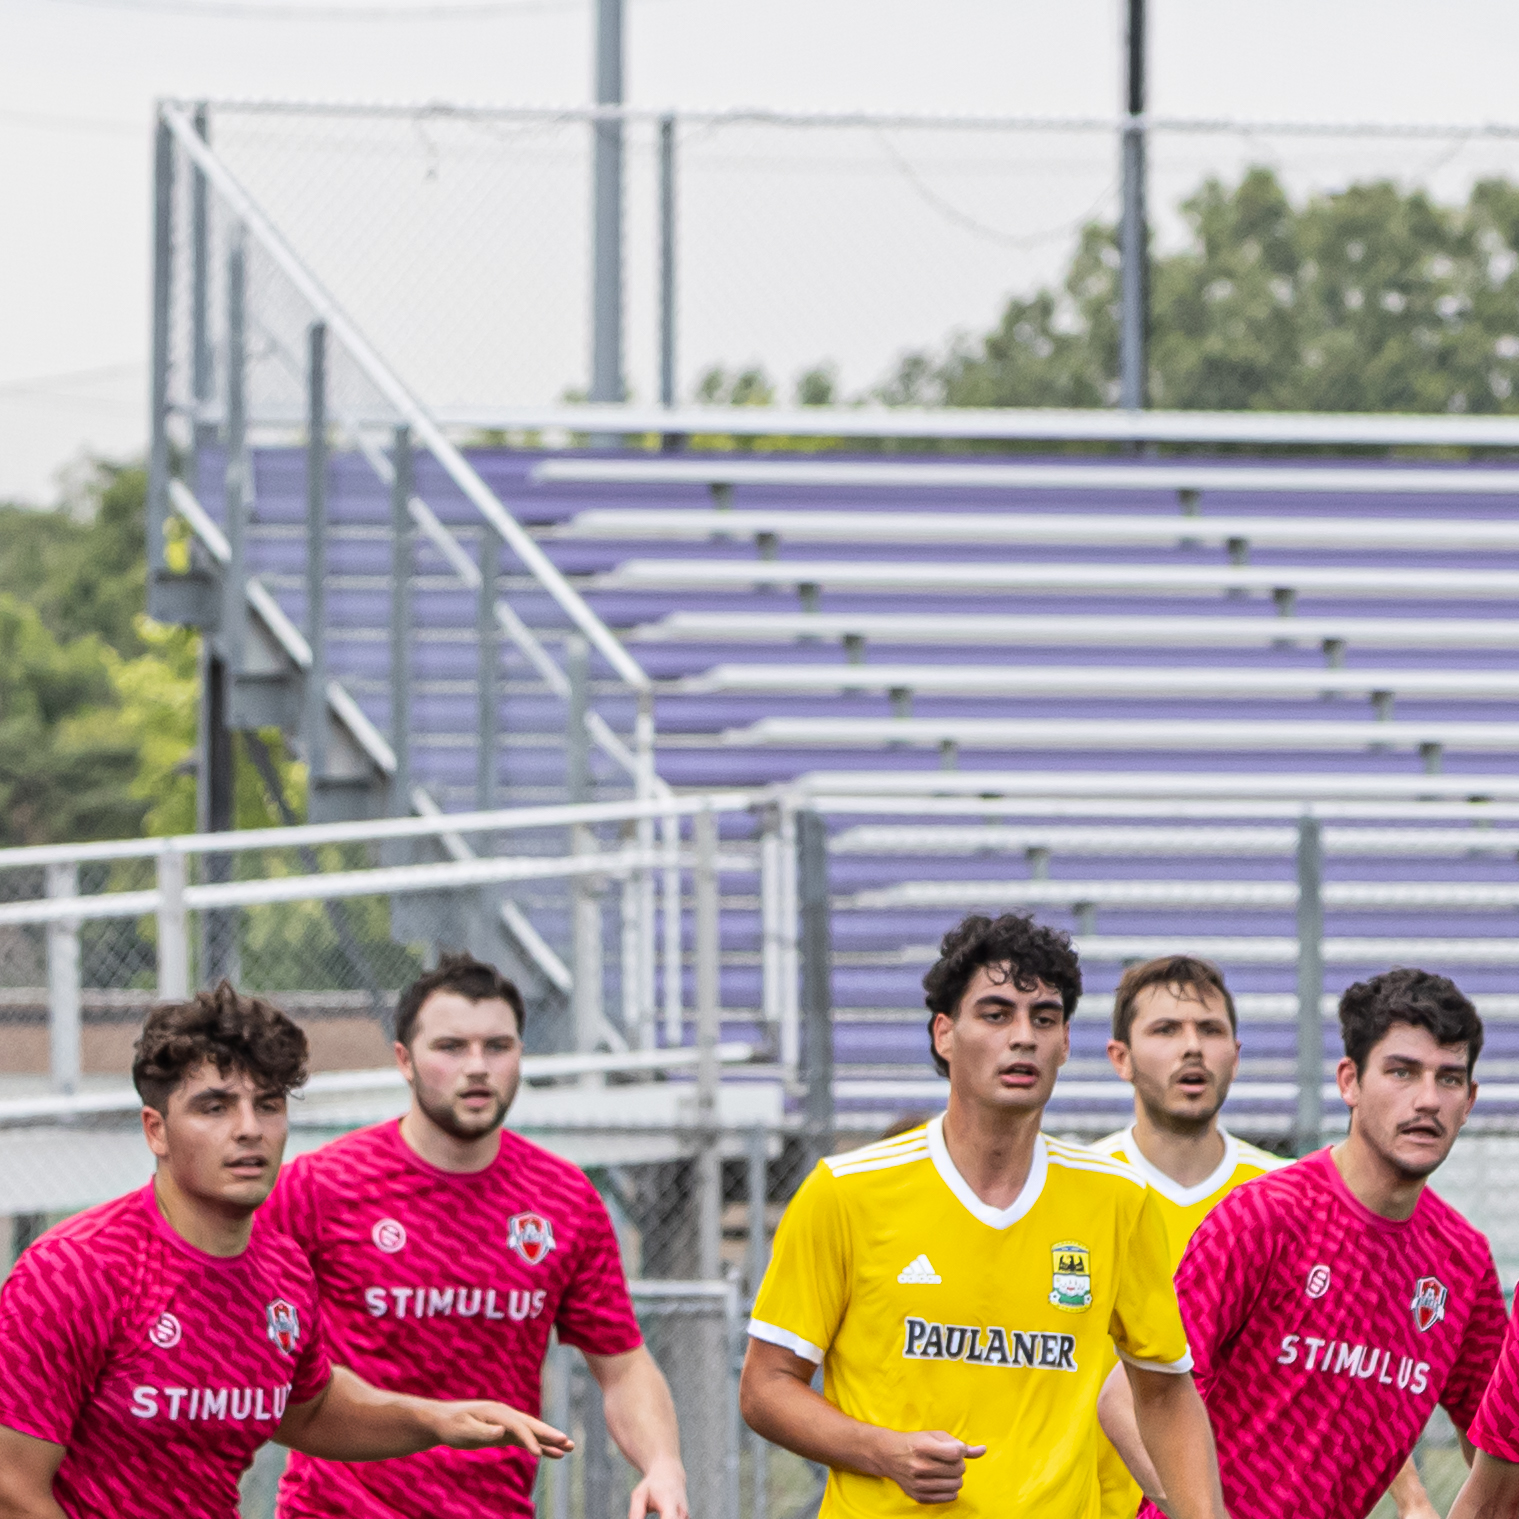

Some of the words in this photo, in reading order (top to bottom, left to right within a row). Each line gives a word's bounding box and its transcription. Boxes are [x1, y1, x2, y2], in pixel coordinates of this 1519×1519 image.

[364, 1286, 547, 1321] STIMULUS
[903, 1317, 1077, 1371] PAULANER
[1277, 1334, 1430, 1394] STIMULUS
[130, 1383, 292, 1420] STIMULU
